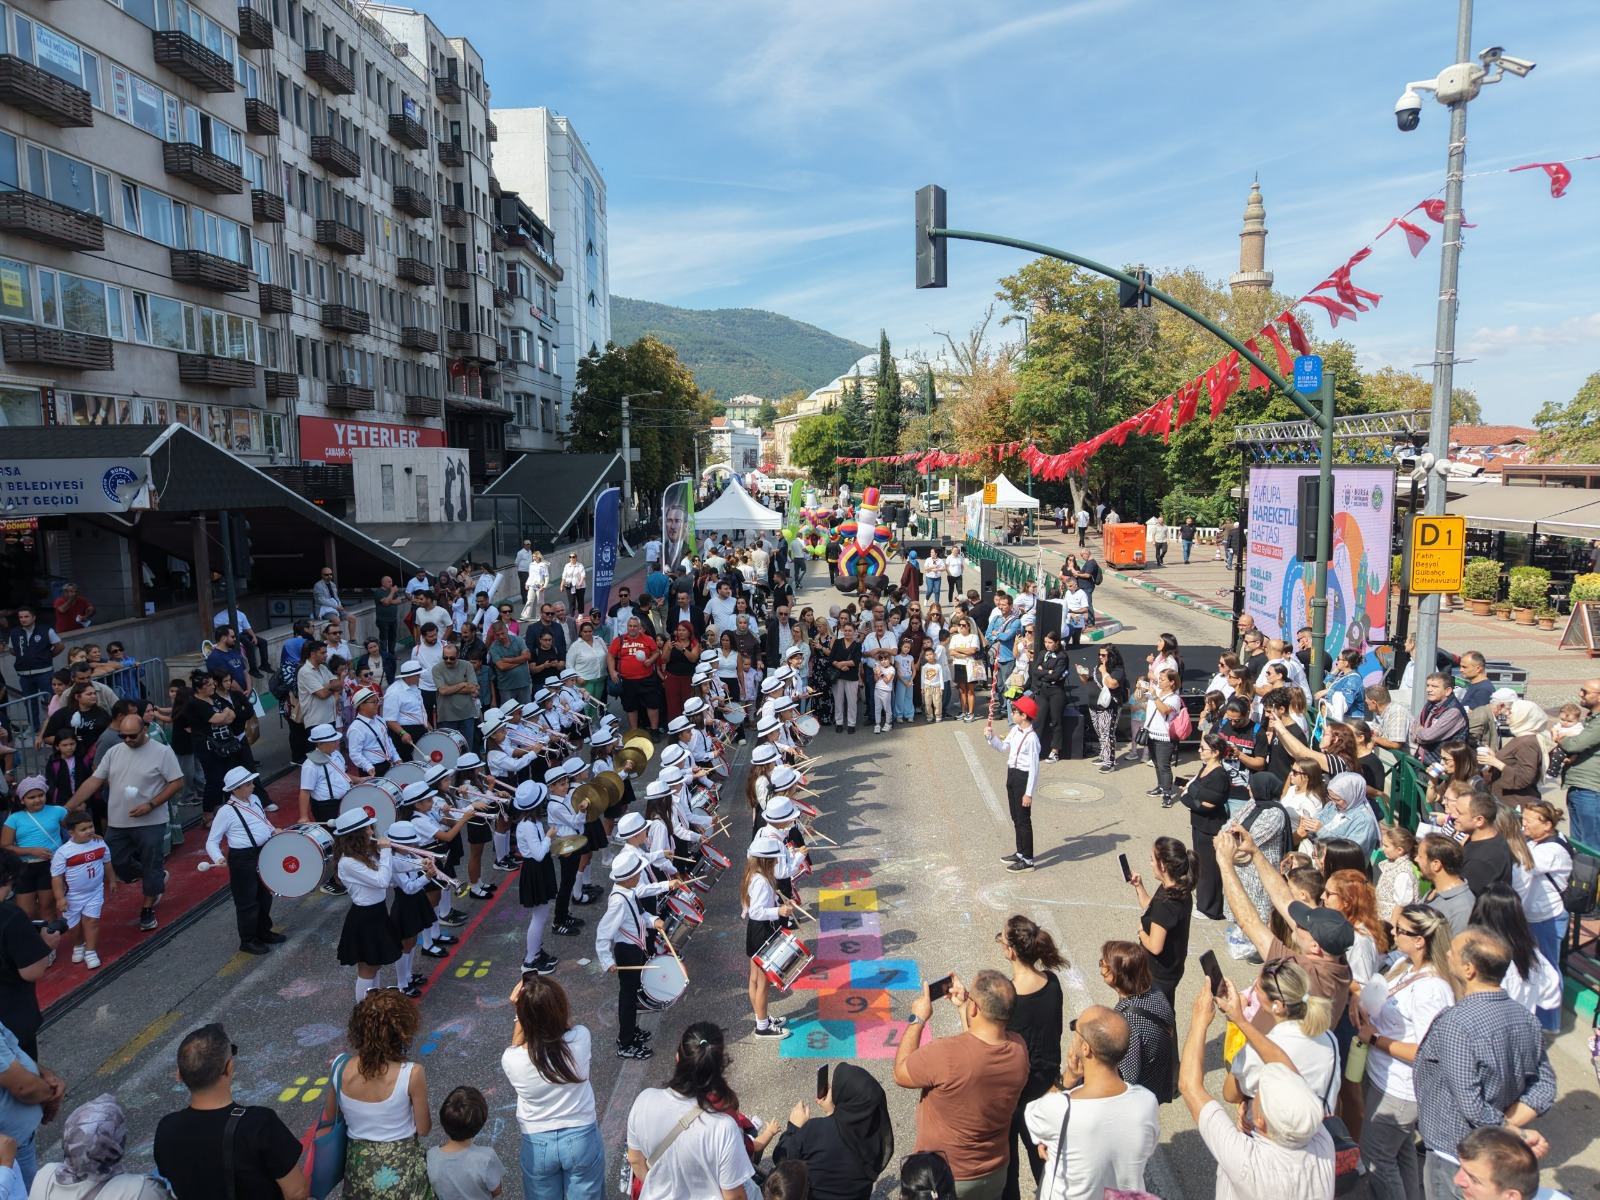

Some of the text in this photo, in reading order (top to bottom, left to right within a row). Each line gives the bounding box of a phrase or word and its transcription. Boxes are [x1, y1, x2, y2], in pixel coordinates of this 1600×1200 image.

[110, 467, 131, 475] BURSA
[7, 478, 84, 491] BELEDİYESİ
[7, 493, 79, 508] ALT GEÇİDİ
[1253, 485, 1282, 503] AVRUPA
[1251, 523, 1280, 545] HAFTASI
[1420, 523, 1452, 546] D 1
[1262, 545, 1272, 556] Eylül
[1414, 577, 1459, 585] Çiftehavuzlar
[87, 867, 96, 879] 11
[840, 917, 860, 930] 2
[840, 940, 861, 955] 3
[809, 965, 830, 981] 5
[807, 1030, 830, 1050] 8
